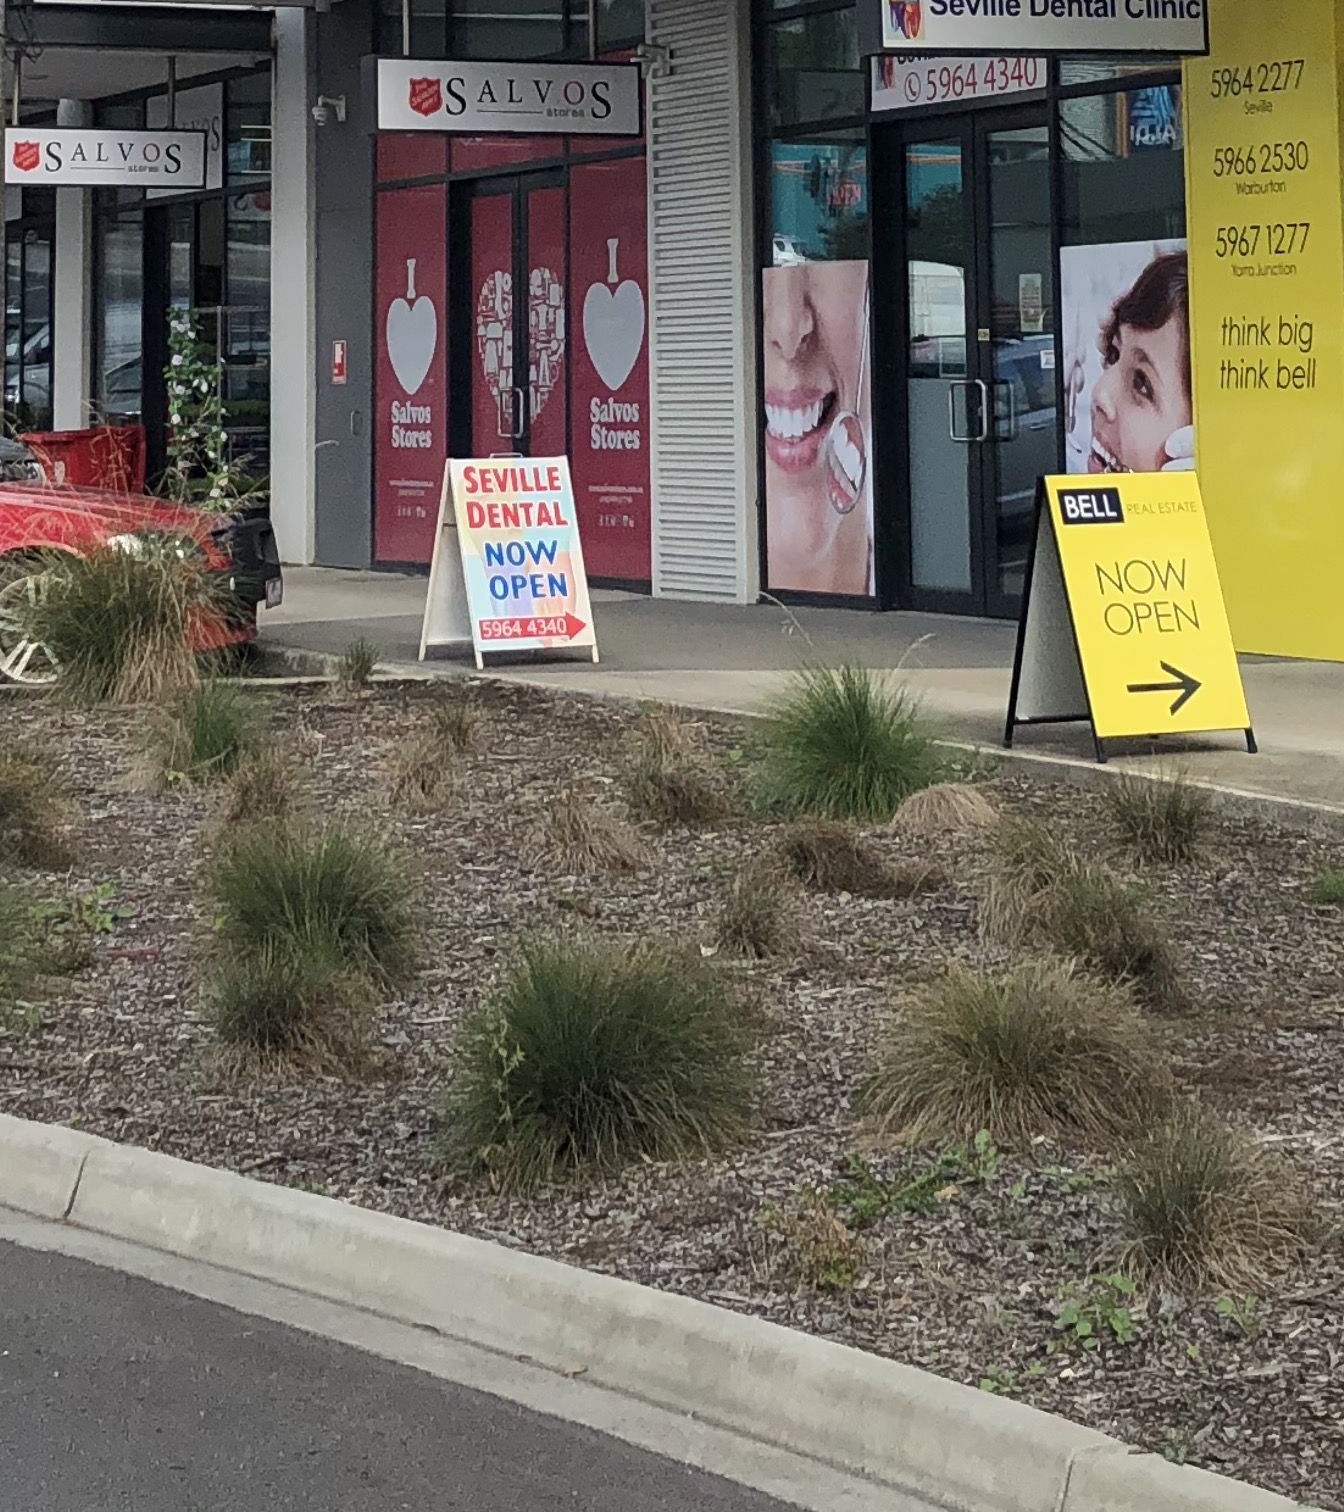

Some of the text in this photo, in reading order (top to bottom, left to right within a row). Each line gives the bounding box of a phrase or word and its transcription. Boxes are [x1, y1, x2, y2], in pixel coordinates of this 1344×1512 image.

[925, 58, 1039, 102] 5964 4340
[1211, 59, 1304, 98] 5964 2277
[446, 77, 612, 119] SALVOS
[45, 141, 182, 174] SALVOS
[1213, 141, 1308, 177] 5966 2530
[1216, 223, 1311, 258] 5967 1277
[1221, 314, 1313, 353] think big
[1220, 358, 1316, 389] think bell
[391, 400, 432, 424] Salvos
[590, 396, 639, 423] Salvos
[391, 425, 432, 448] Stores
[590, 424, 640, 449] Stores
[463, 466, 562, 495] SEVILLE
[466, 501, 568, 529] DENTAL
[1064, 494, 1117, 519] BELL
[1158, 501, 1197, 514] ESTATE
[485, 540, 558, 567] NOW
[489, 573, 568, 600] OPEN
[1095, 558, 1186, 595] NOW
[483, 618, 567, 638] 5964 4340
[1104, 600, 1200, 635] OPEN
